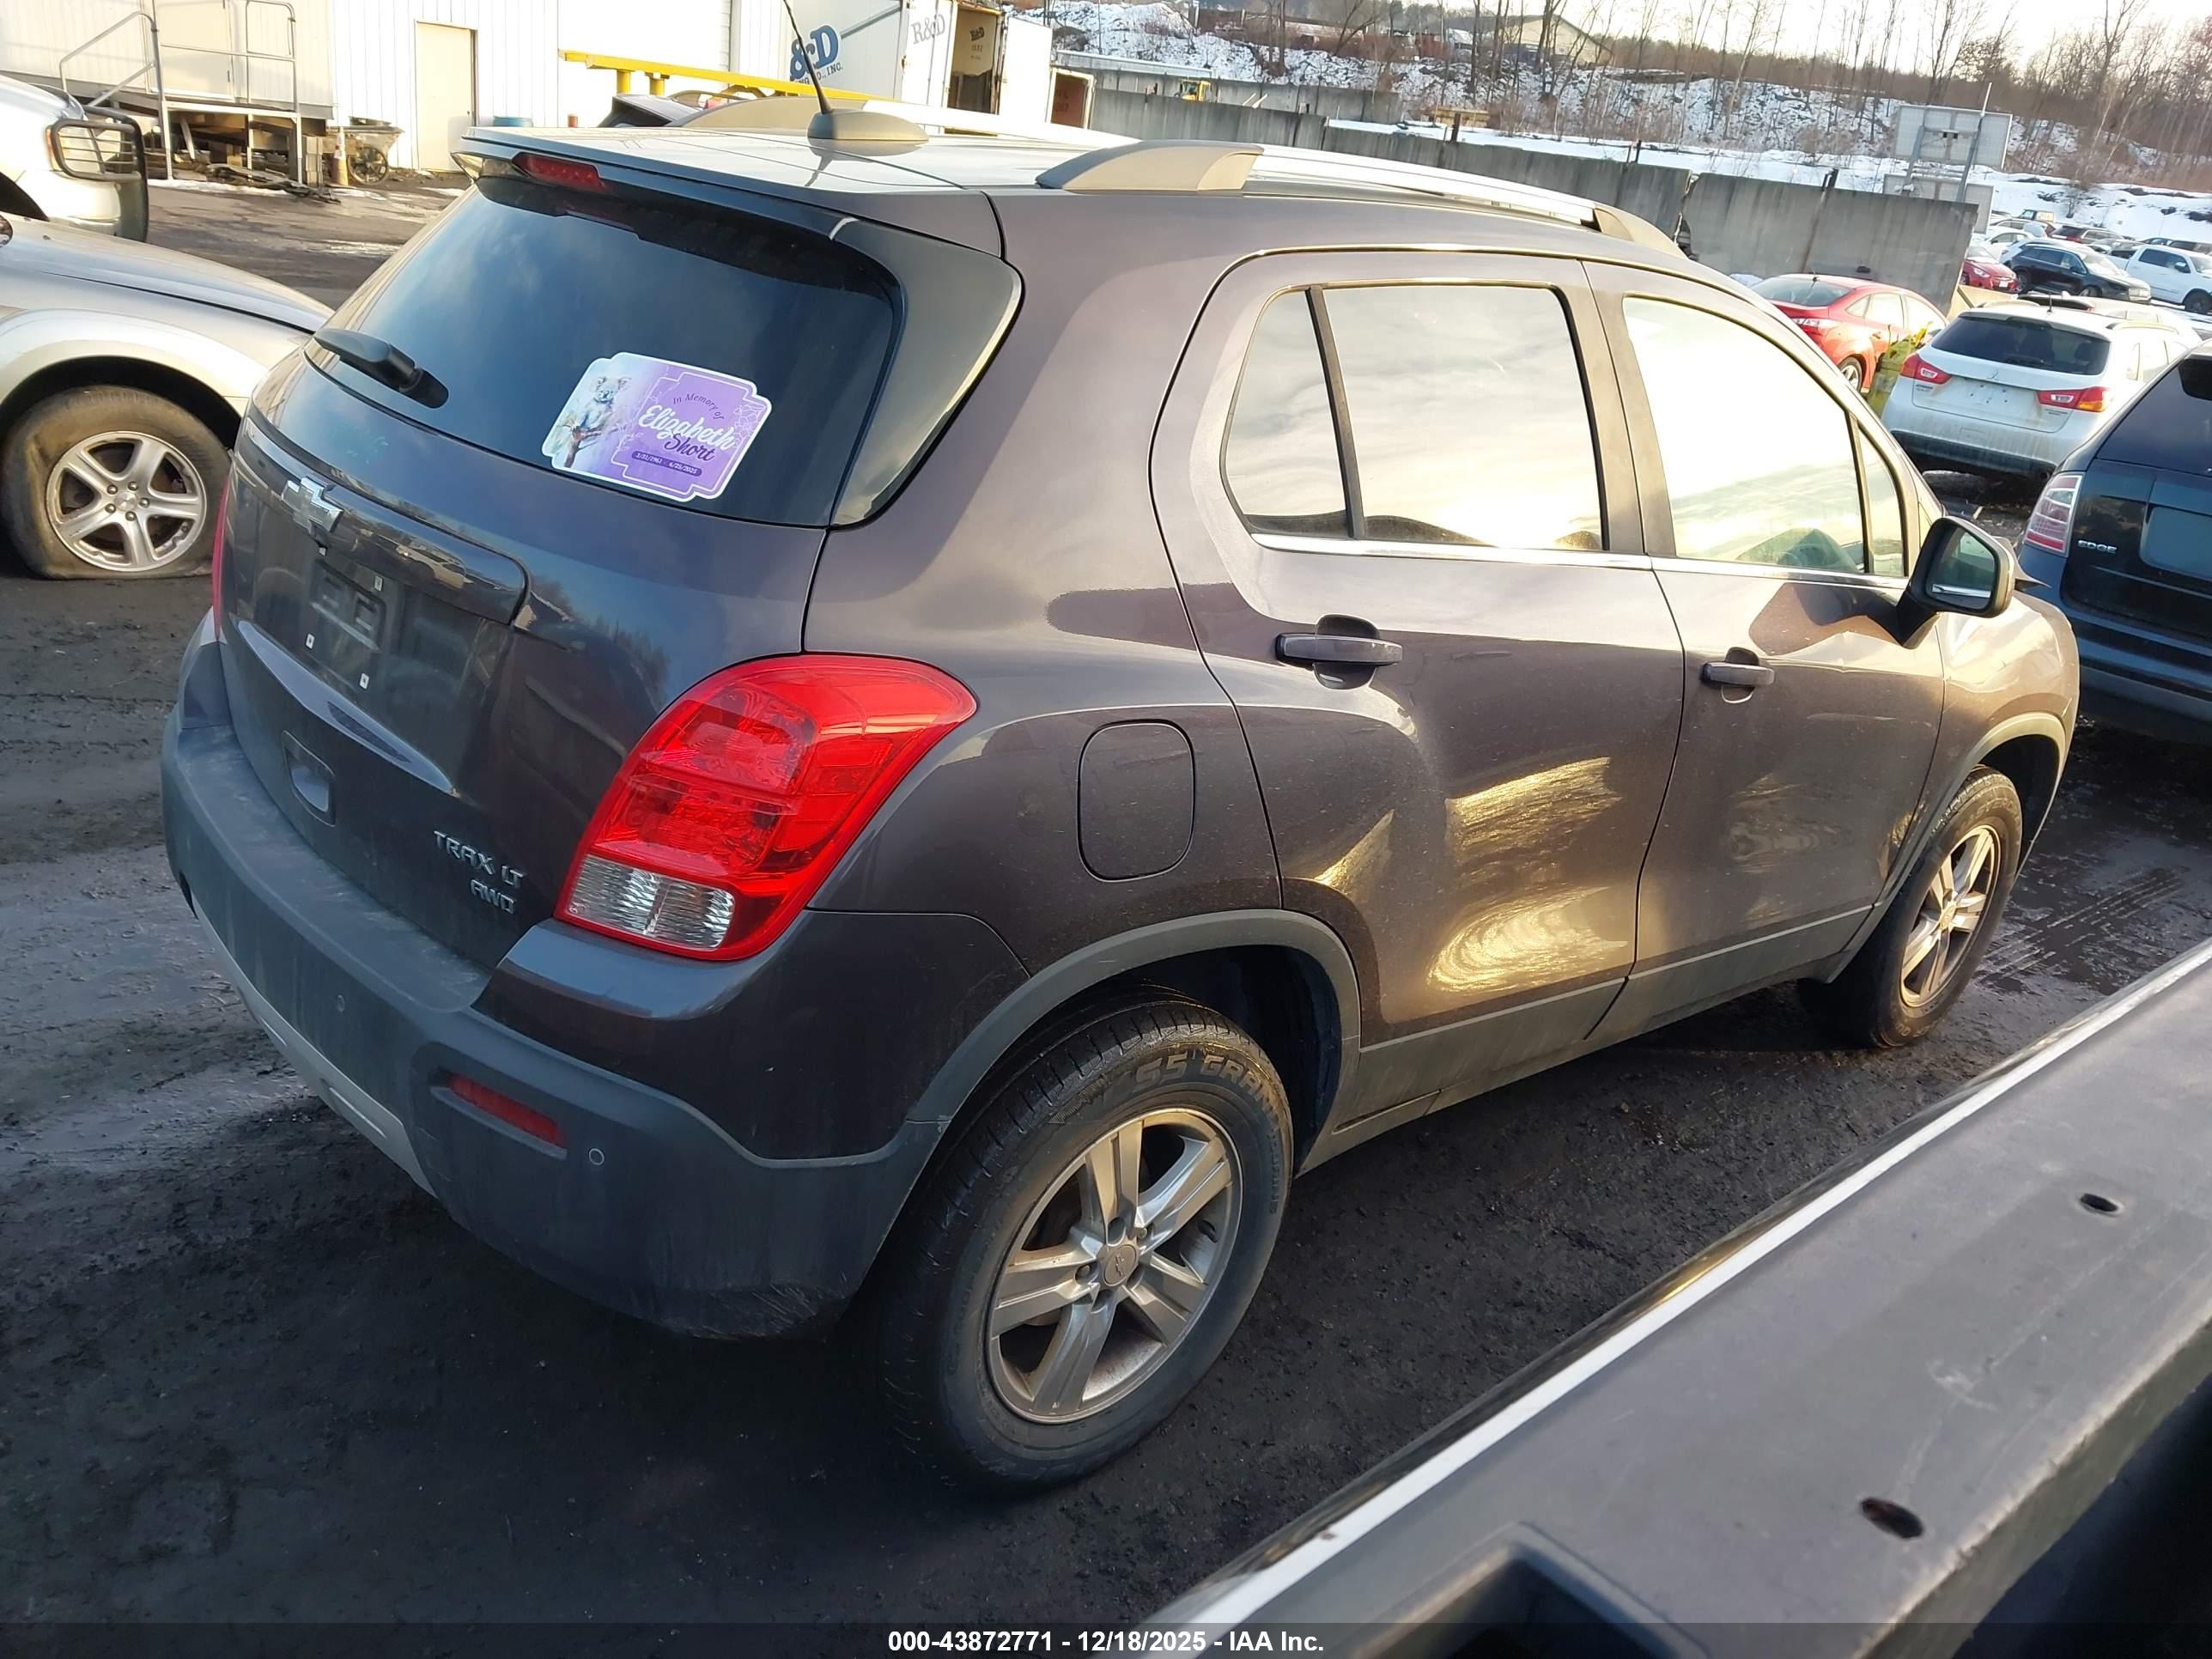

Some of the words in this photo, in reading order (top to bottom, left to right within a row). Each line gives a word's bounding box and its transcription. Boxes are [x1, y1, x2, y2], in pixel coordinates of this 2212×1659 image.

[684, 393, 720, 411] Memory
[713, 411, 725, 420] of
[638, 404, 737, 451] Elizabeth
[664, 433, 716, 461] Short
[2078, 539, 2118, 554] EDGE
[434, 830, 495, 876] TRAX
[501, 865, 524, 888] LT
[470, 878, 515, 915] AWD
